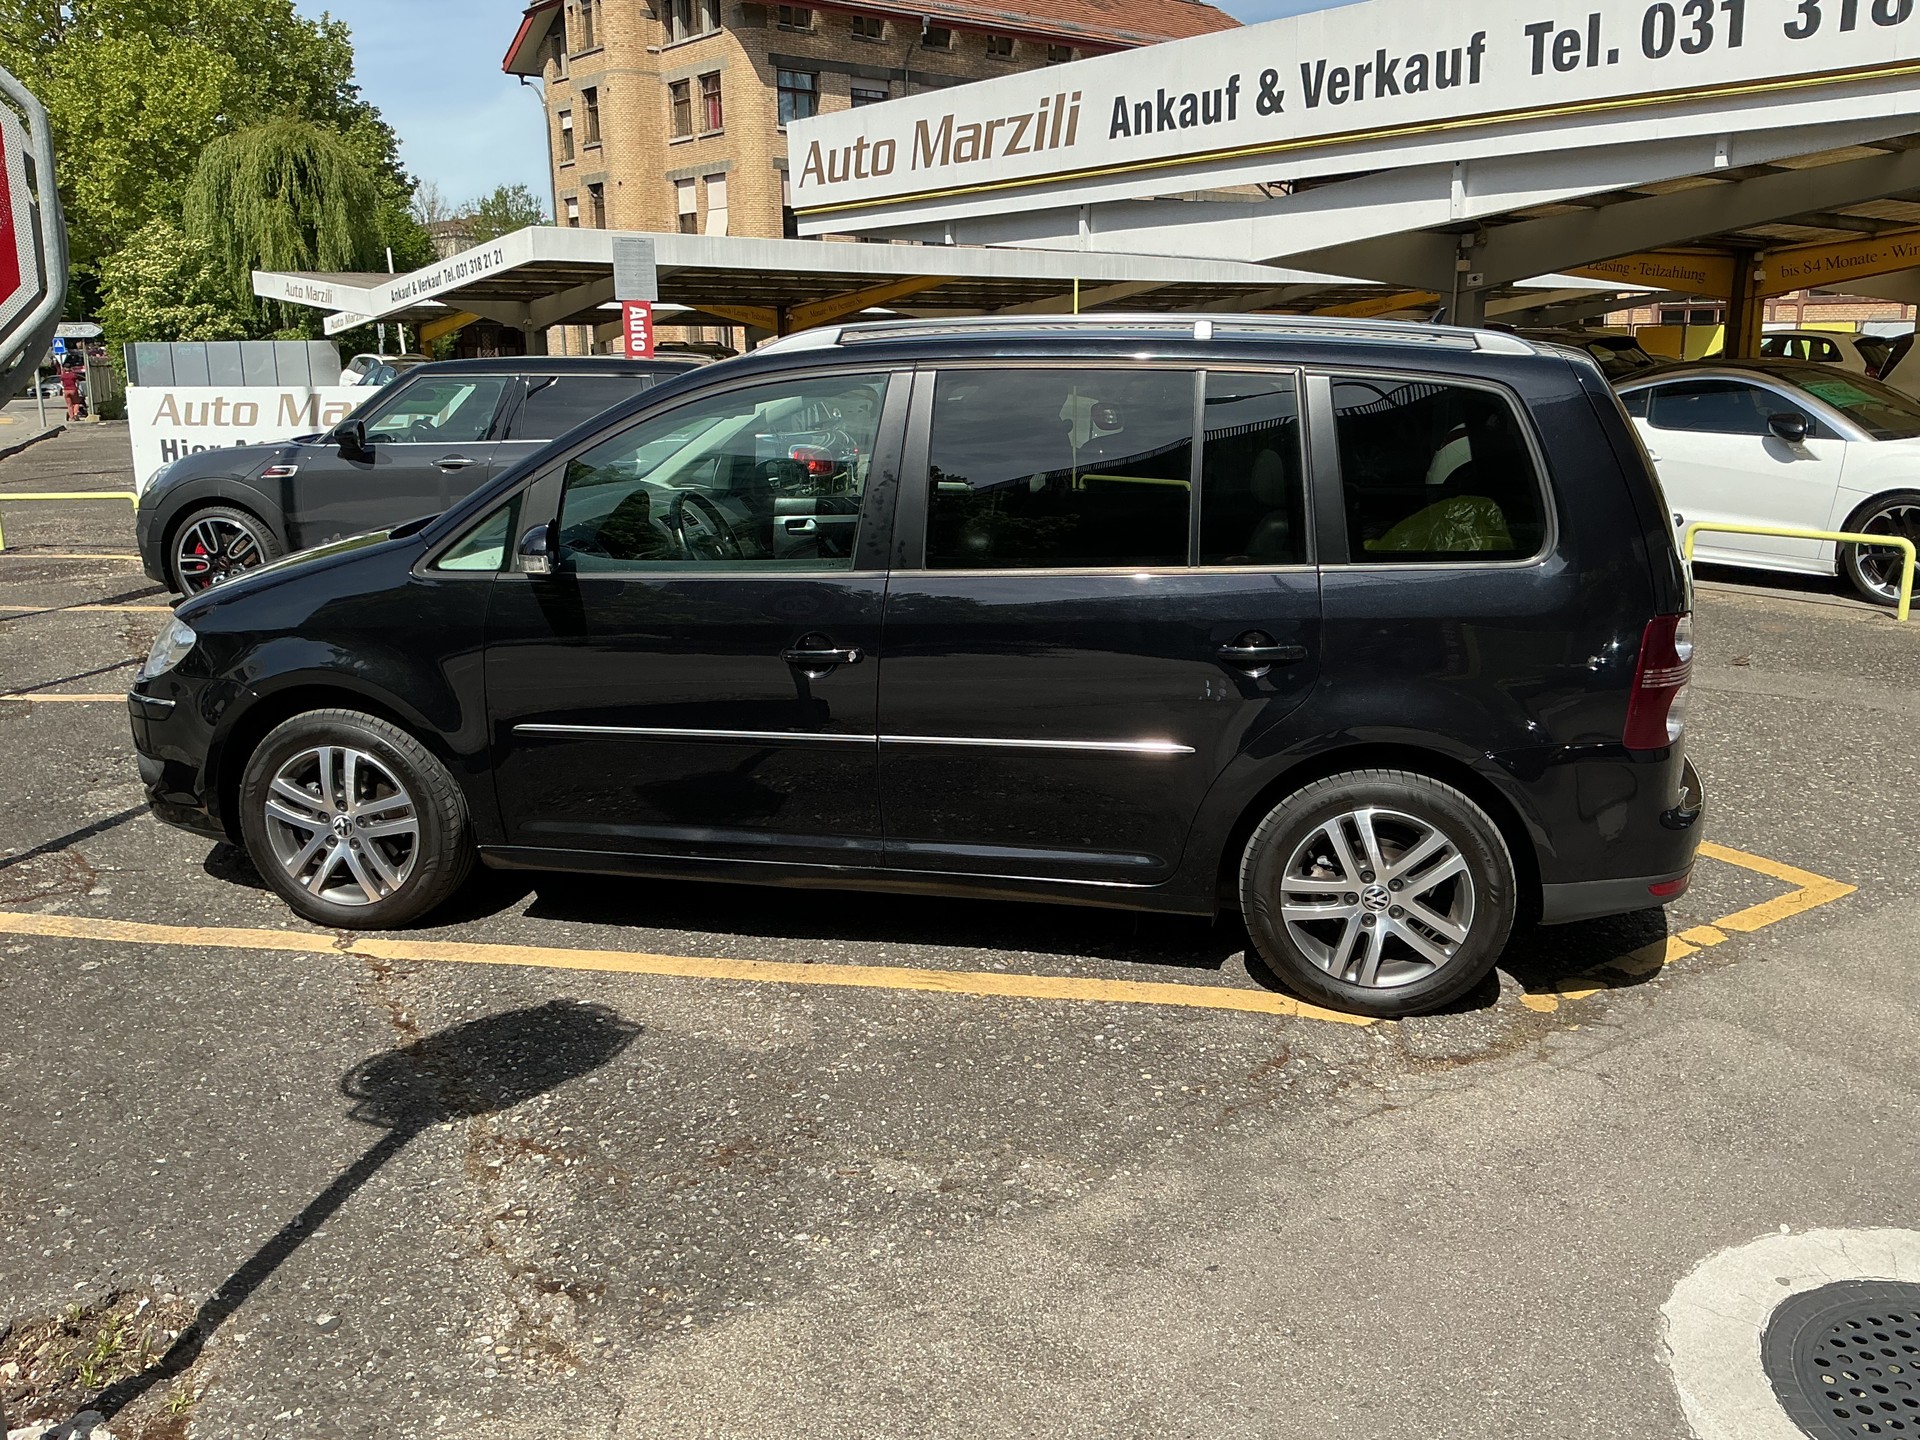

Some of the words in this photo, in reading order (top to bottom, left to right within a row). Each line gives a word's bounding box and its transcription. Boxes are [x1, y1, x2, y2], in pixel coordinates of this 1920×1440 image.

[799, 137, 896, 188] Auto
[911, 90, 1082, 171] Marzili
[1109, 74, 1240, 140] Ankauf
[1256, 68, 1285, 116] &
[1300, 31, 1486, 108] Verkauf
[1525, 12, 1619, 75] Tel.
[1641, 0, 1745, 59] 031
[391, 283, 411, 303] Ankauf
[417, 271, 442, 293] Verkauf
[444, 266, 456, 283] Tel.
[456, 262, 468, 279] 031
[469, 256, 482, 274] 318
[483, 252, 492, 269] 21
[494, 248, 503, 264] 21
[1639, 262, 1705, 284] Teilzahlung
[1781, 265, 1799, 278] bis
[1804, 260, 1821, 274] 84
[1825, 253, 1877, 270] Monate
[285, 282, 303, 298] Auto
[306, 285, 332, 304] Marzili
[629, 306, 648, 351] Auto
[151, 393, 259, 427] Auto
